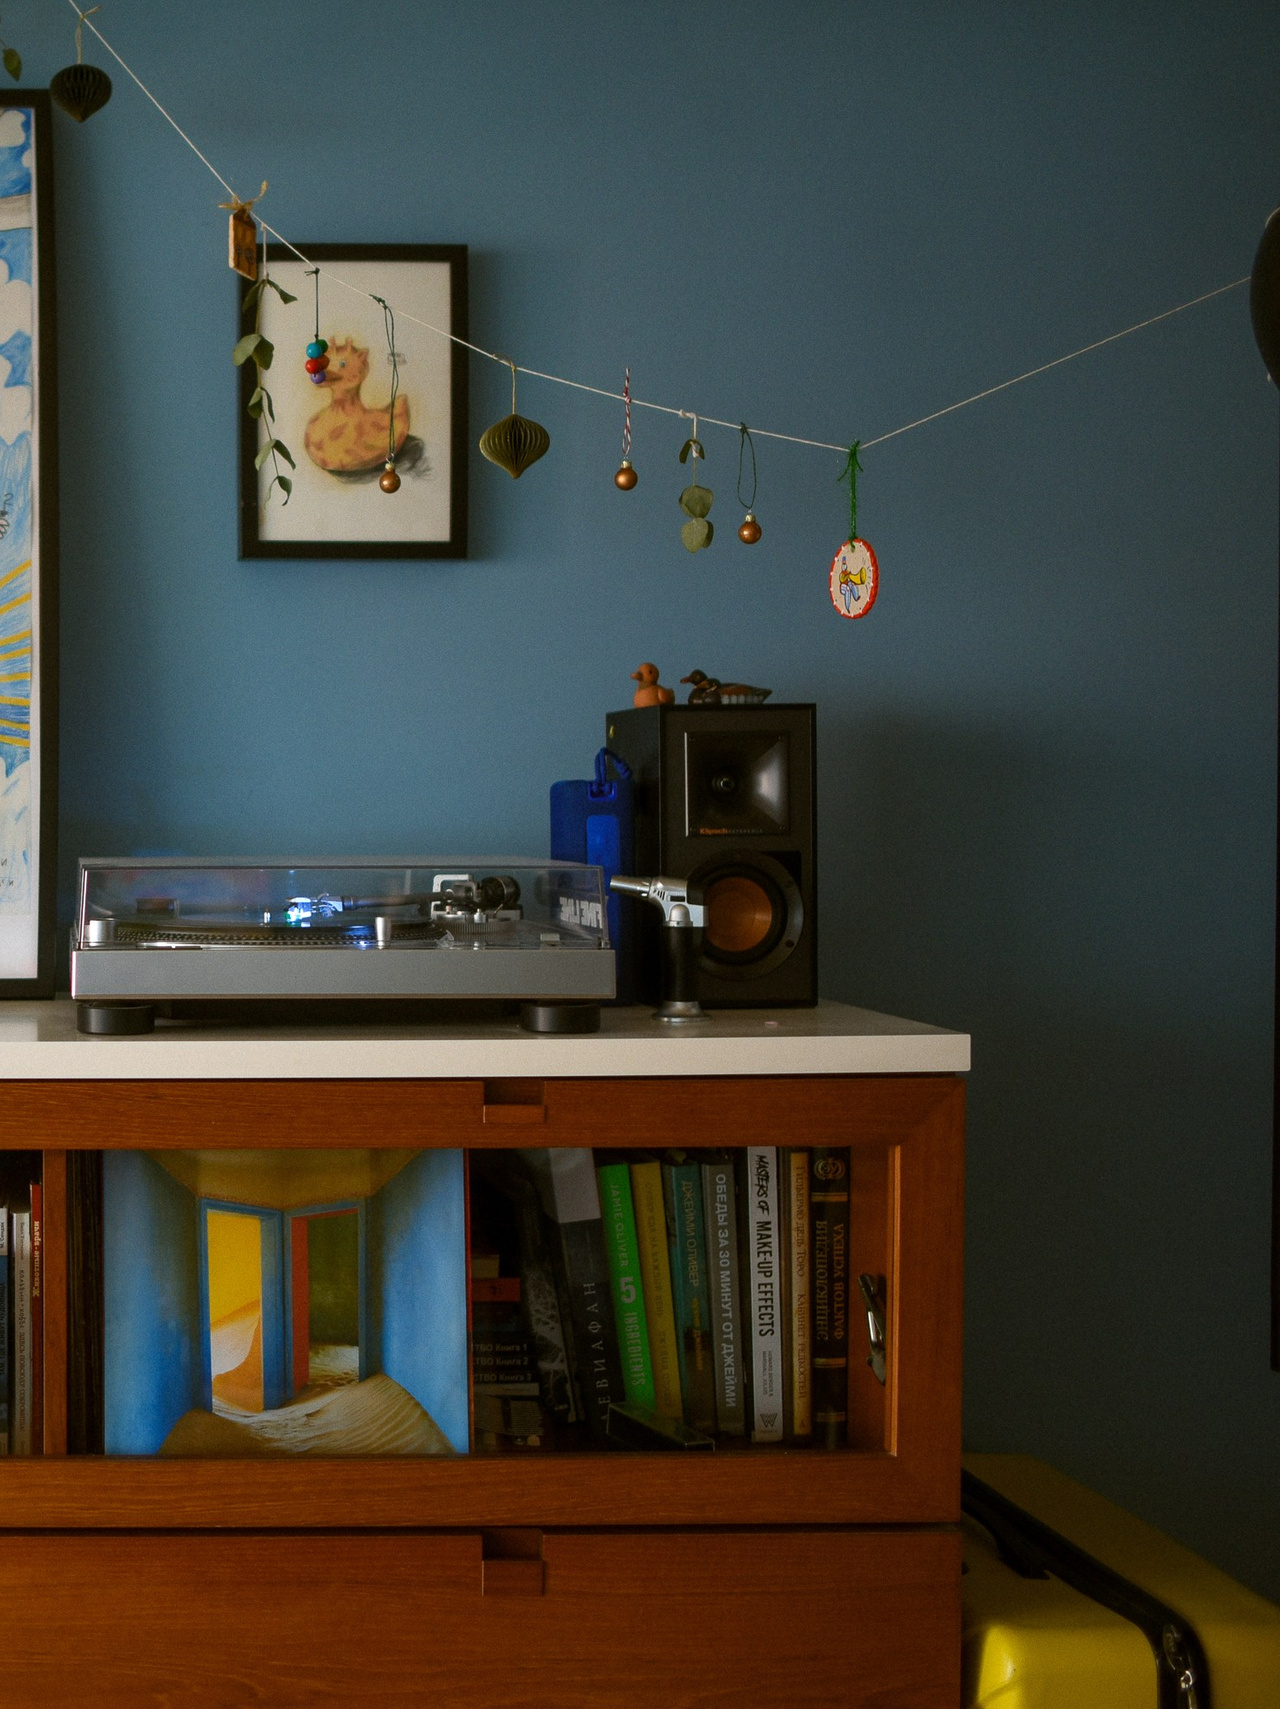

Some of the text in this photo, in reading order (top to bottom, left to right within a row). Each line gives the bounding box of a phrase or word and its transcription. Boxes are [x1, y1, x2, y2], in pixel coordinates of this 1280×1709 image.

[609, 1183, 629, 1268] JAMIE OLIVER
[681, 1180, 699, 1287] ДЖЕЙМИ ОЛИВЕР
[755, 1221, 773, 1278] MAKE-UP
[619, 1276, 646, 1386] 5 INGREDIENTS
[714, 1173, 737, 1407] ОБЕДЫ ЗА 30 МИНУТ ОТ ДЖЕЙМИ
[757, 1282, 775, 1337] EFFECTS
[816, 1220, 830, 1340] ЭНЦИКЛОПЕДИЯ
[833, 1223, 844, 1339] ФАКТОВ УСПЕХА
